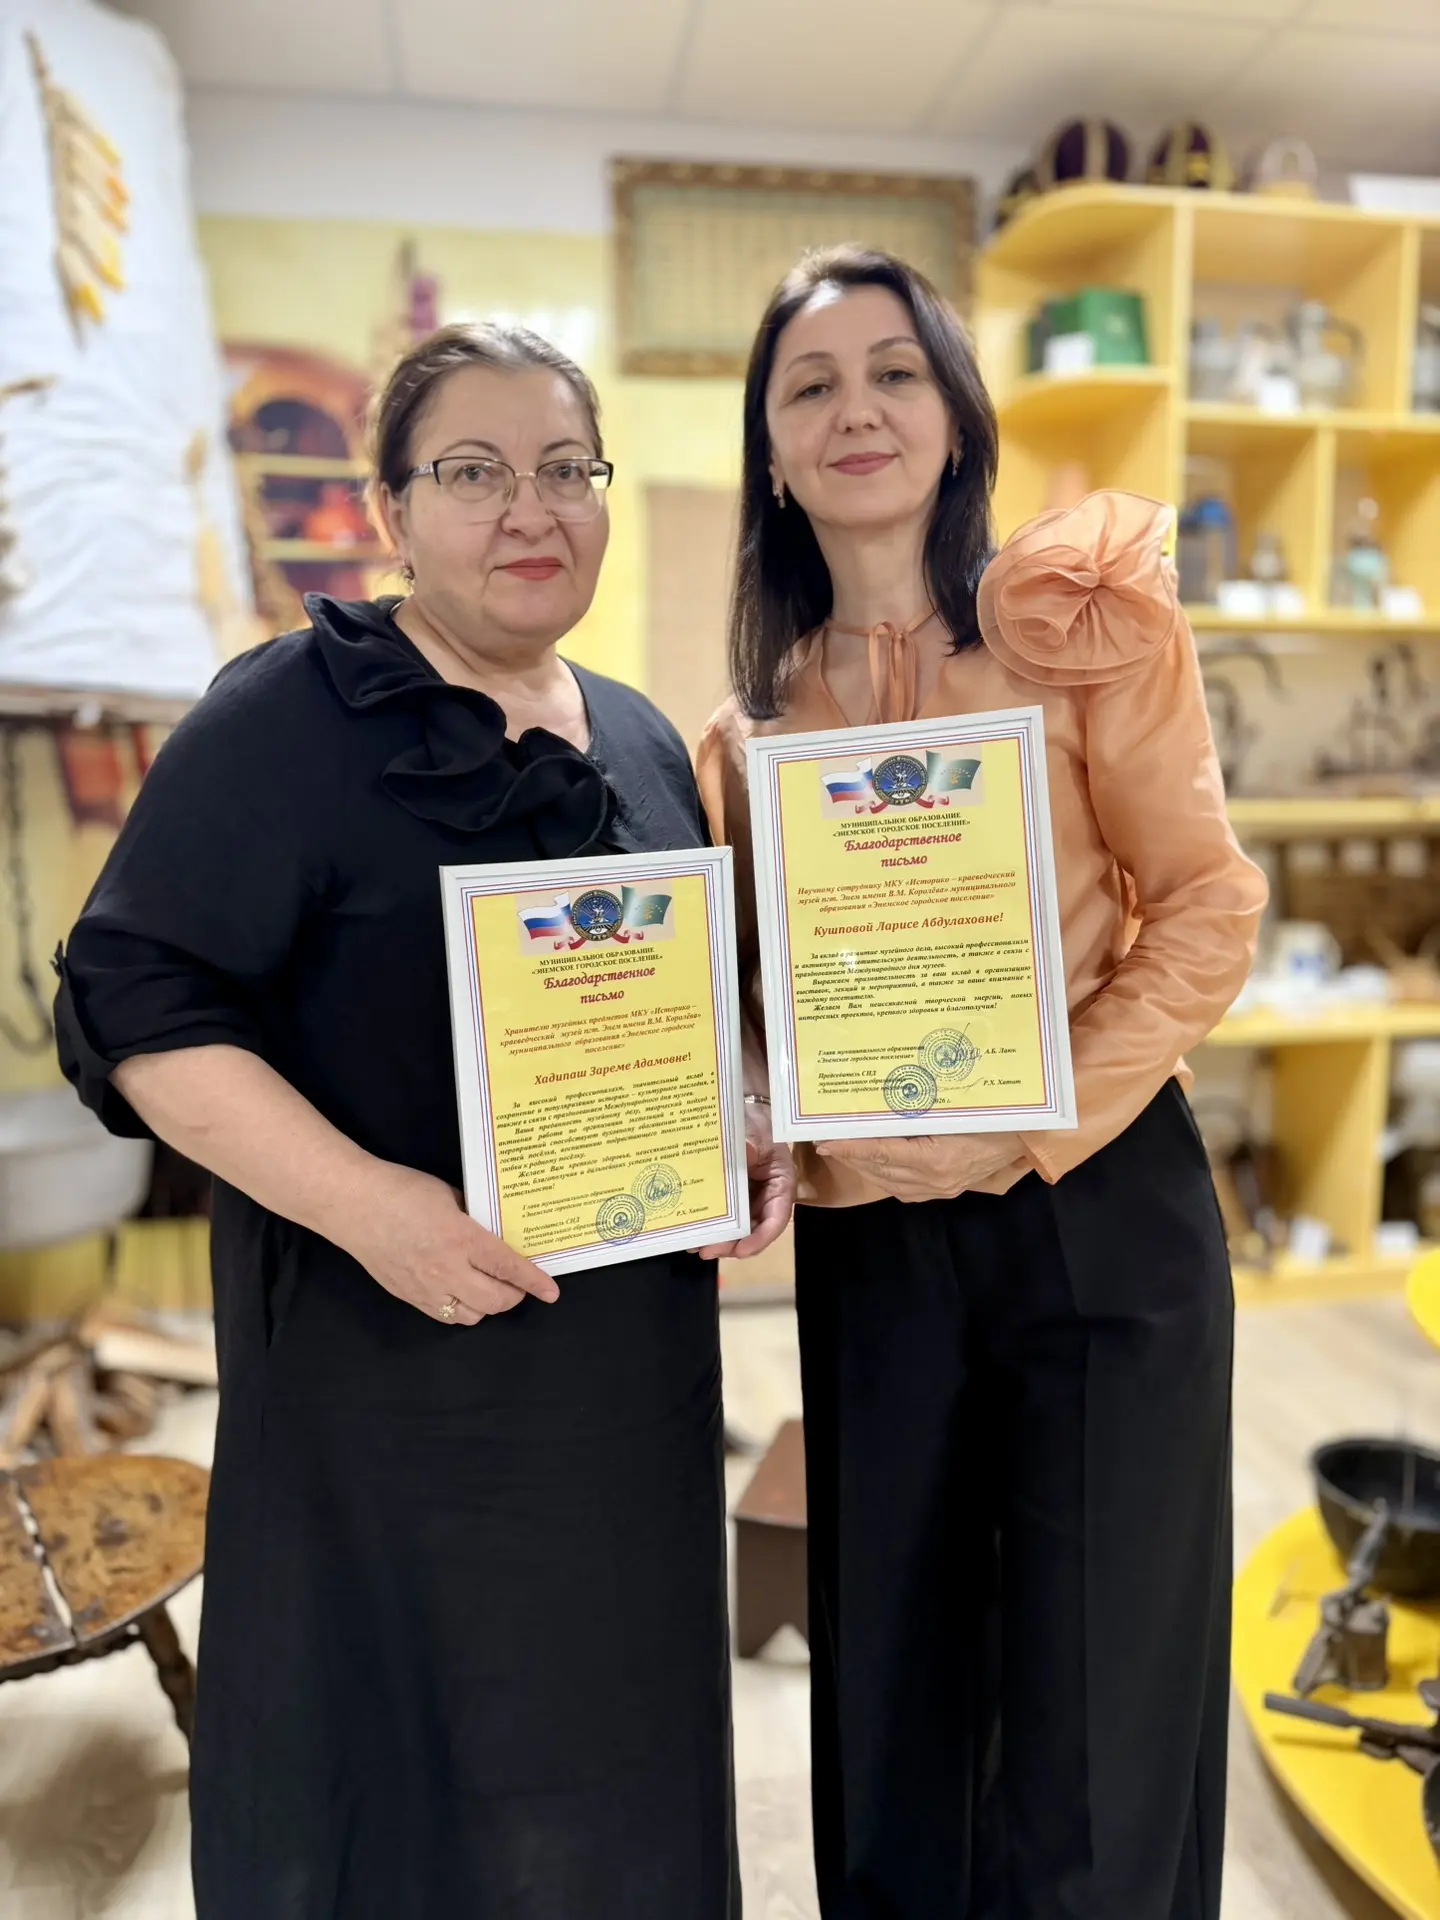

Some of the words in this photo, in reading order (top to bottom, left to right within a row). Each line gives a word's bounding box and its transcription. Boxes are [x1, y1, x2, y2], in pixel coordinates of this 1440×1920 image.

[832, 827, 876, 837] «ЭНЕМСКОЕ
[876, 823, 920, 833] ГОРОДСКОЕ
[921, 819, 970, 829] ПОСЕЛЕНИЕ»
[840, 817, 907, 829] МУНИЦИПАЛЬНОЕ
[907, 812, 961, 823] ОБРАЗОВАНИЕ
[844, 832, 962, 851] Благодарственное
[880, 855, 927, 867] письмо
[797, 886, 835, 896] Научному
[836, 883, 882, 892] сотруднику
[883, 879, 904, 888] МКУ
[904, 877, 950, 886] «Историко
[957, 870, 1015, 883] краеведческий
[797, 896, 820, 906] музей
[839, 893, 860, 901] Энем
[888, 889, 906, 897] В.М.
[907, 886, 948, 896] Королёва»
[949, 881, 1016, 894] муниципального
[819, 903, 866, 914] образования
[867, 900, 909, 908] «Энемское
[910, 896, 948, 907] городское
[950, 893, 994, 902] поселение»
[813, 922, 873, 938] Кушповой
[875, 920, 919, 932] Ларисе
[921, 912, 1003, 928] Абдулаховне!
[531, 964, 574, 974] «ЭНЕМСКОЕ
[575, 958, 617, 970] ГОРОДСКОЕ
[618, 953, 663, 964] ПОСЕЛЕНИЕ»
[539, 952, 604, 966] МУНИЦИПАЛЬНОЕ
[605, 947, 654, 958] ОБРАЗОВАНИЕ
[837, 957, 904, 967] просетительскую
[845, 950, 878, 958] равитие
[543, 967, 655, 989] Благодарственное
[580, 990, 624, 1004] письмо
[499, 1032, 555, 1047] краеведческий
[560, 1028, 582, 1039] музей
[601, 1024, 621, 1032] Энем
[622, 1020, 646, 1028] имени
[646, 1016, 663, 1025] В.М.
[665, 1012, 701, 1023] Королёва»
[504, 1024, 549, 1037] Хранителю
[550, 1019, 587, 1030] музейных
[588, 1013, 628, 1025] предметов
[629, 1008, 649, 1018] МКУ
[650, 1004, 690, 1015] «Историко
[508, 1041, 571, 1056] муниципального
[574, 1033, 620, 1046] образования
[621, 1027, 660, 1038] «Энемское
[660, 1022, 695, 1033] городское
[584, 1043, 625, 1054] поселение»
[534, 1069, 587, 1085] Хадипаш
[589, 1062, 631, 1077] Зареме
[632, 1051, 691, 1069] Адамовне!
